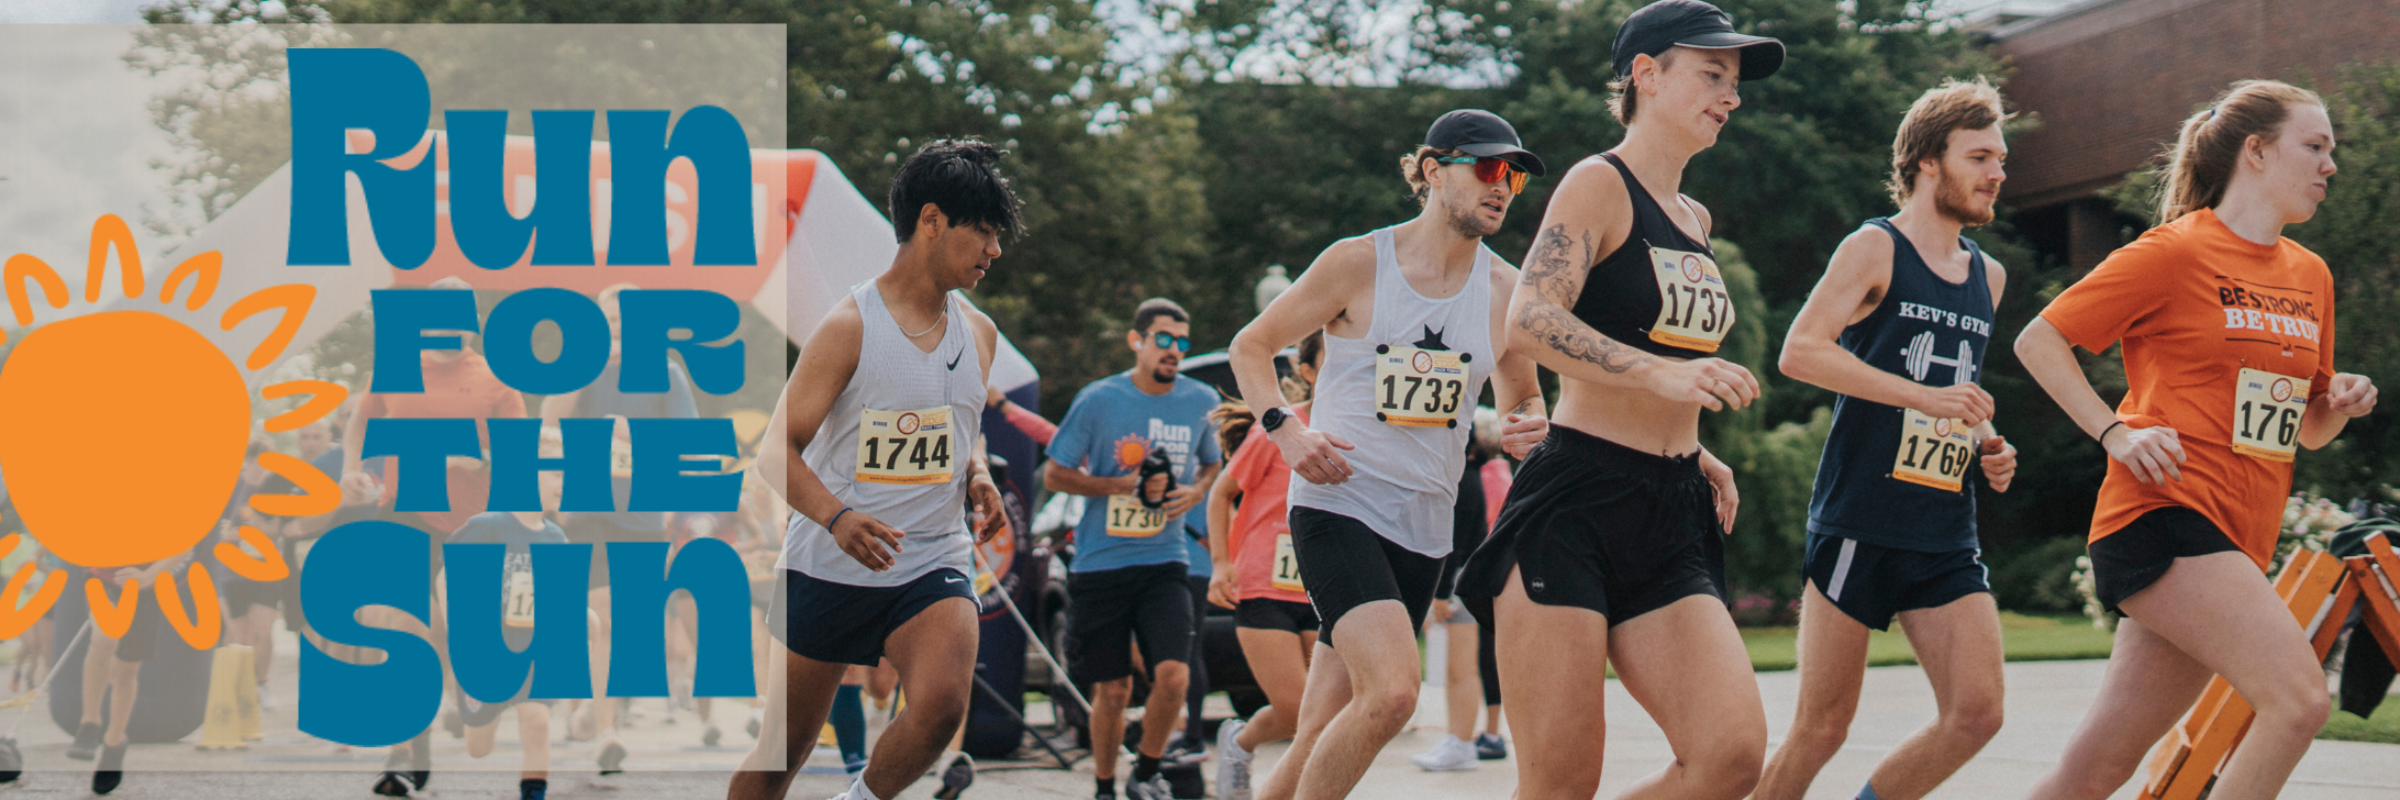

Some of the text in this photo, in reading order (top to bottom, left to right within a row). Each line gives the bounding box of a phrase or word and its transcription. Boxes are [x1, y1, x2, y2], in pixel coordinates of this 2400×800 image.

[1665, 282, 1728, 334] 1737
[2219, 287, 2248, 306] BE
[1899, 301, 1990, 338] KEV'S GYM
[2223, 308, 2264, 330] BE
[1382, 374, 1462, 414] 1733
[1148, 418, 1191, 443] Run
[2241, 400, 2304, 447] 176
[864, 434, 950, 470] 1744
[1902, 434, 1969, 478] 1769
